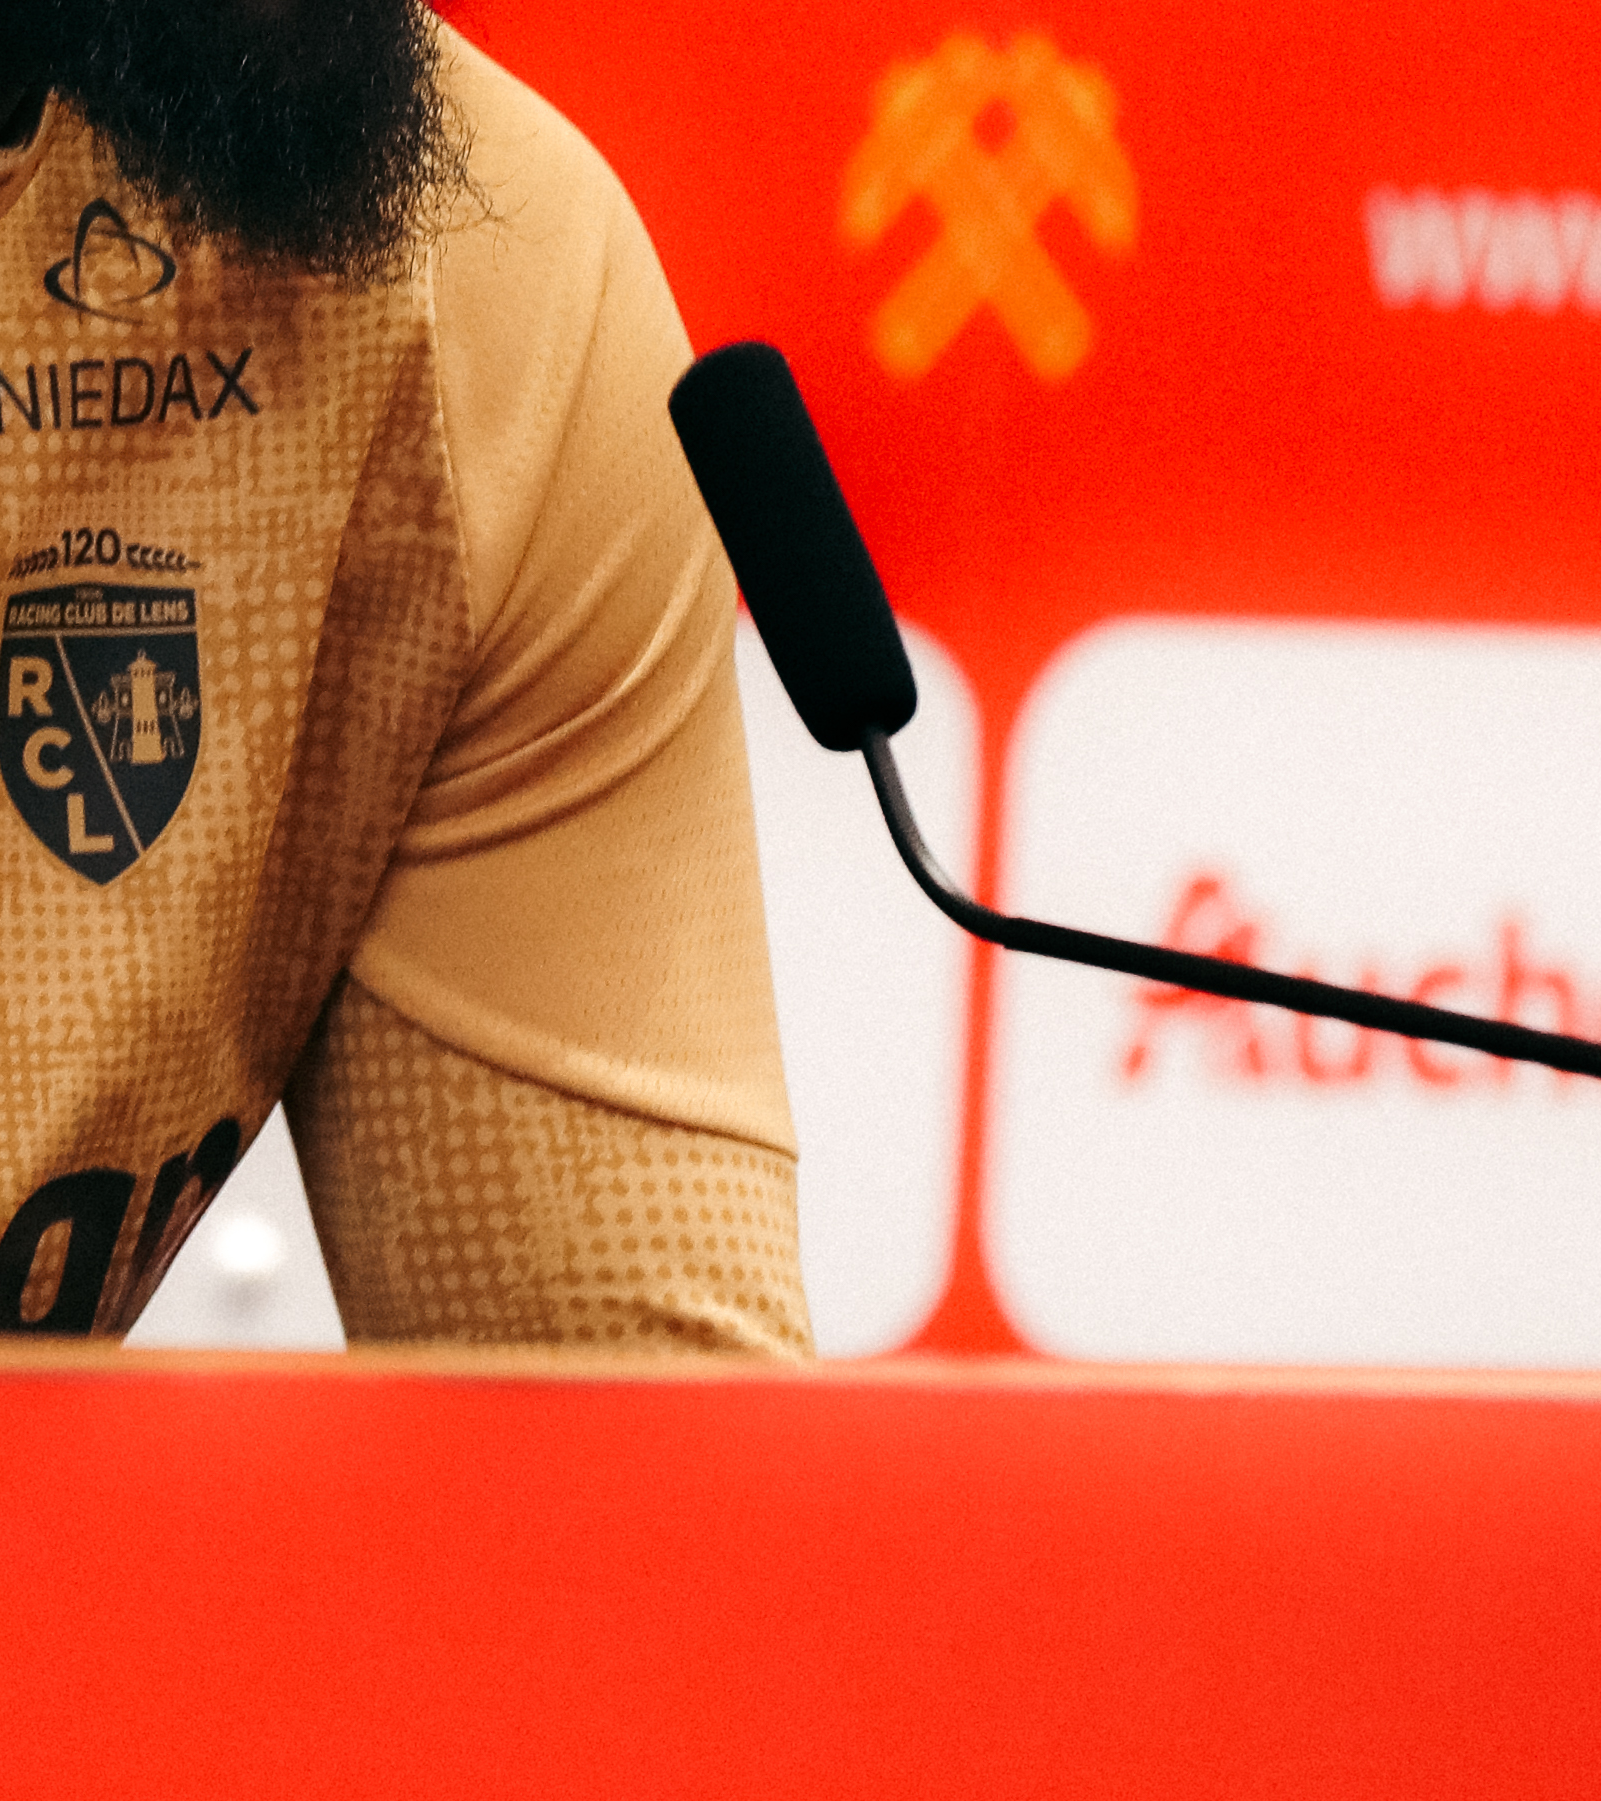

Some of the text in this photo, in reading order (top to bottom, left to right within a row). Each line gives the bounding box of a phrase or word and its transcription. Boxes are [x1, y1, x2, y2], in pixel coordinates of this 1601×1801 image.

[61, 526, 123, 567] 120
[8, 599, 190, 627] RACING CLUB DE LENS
